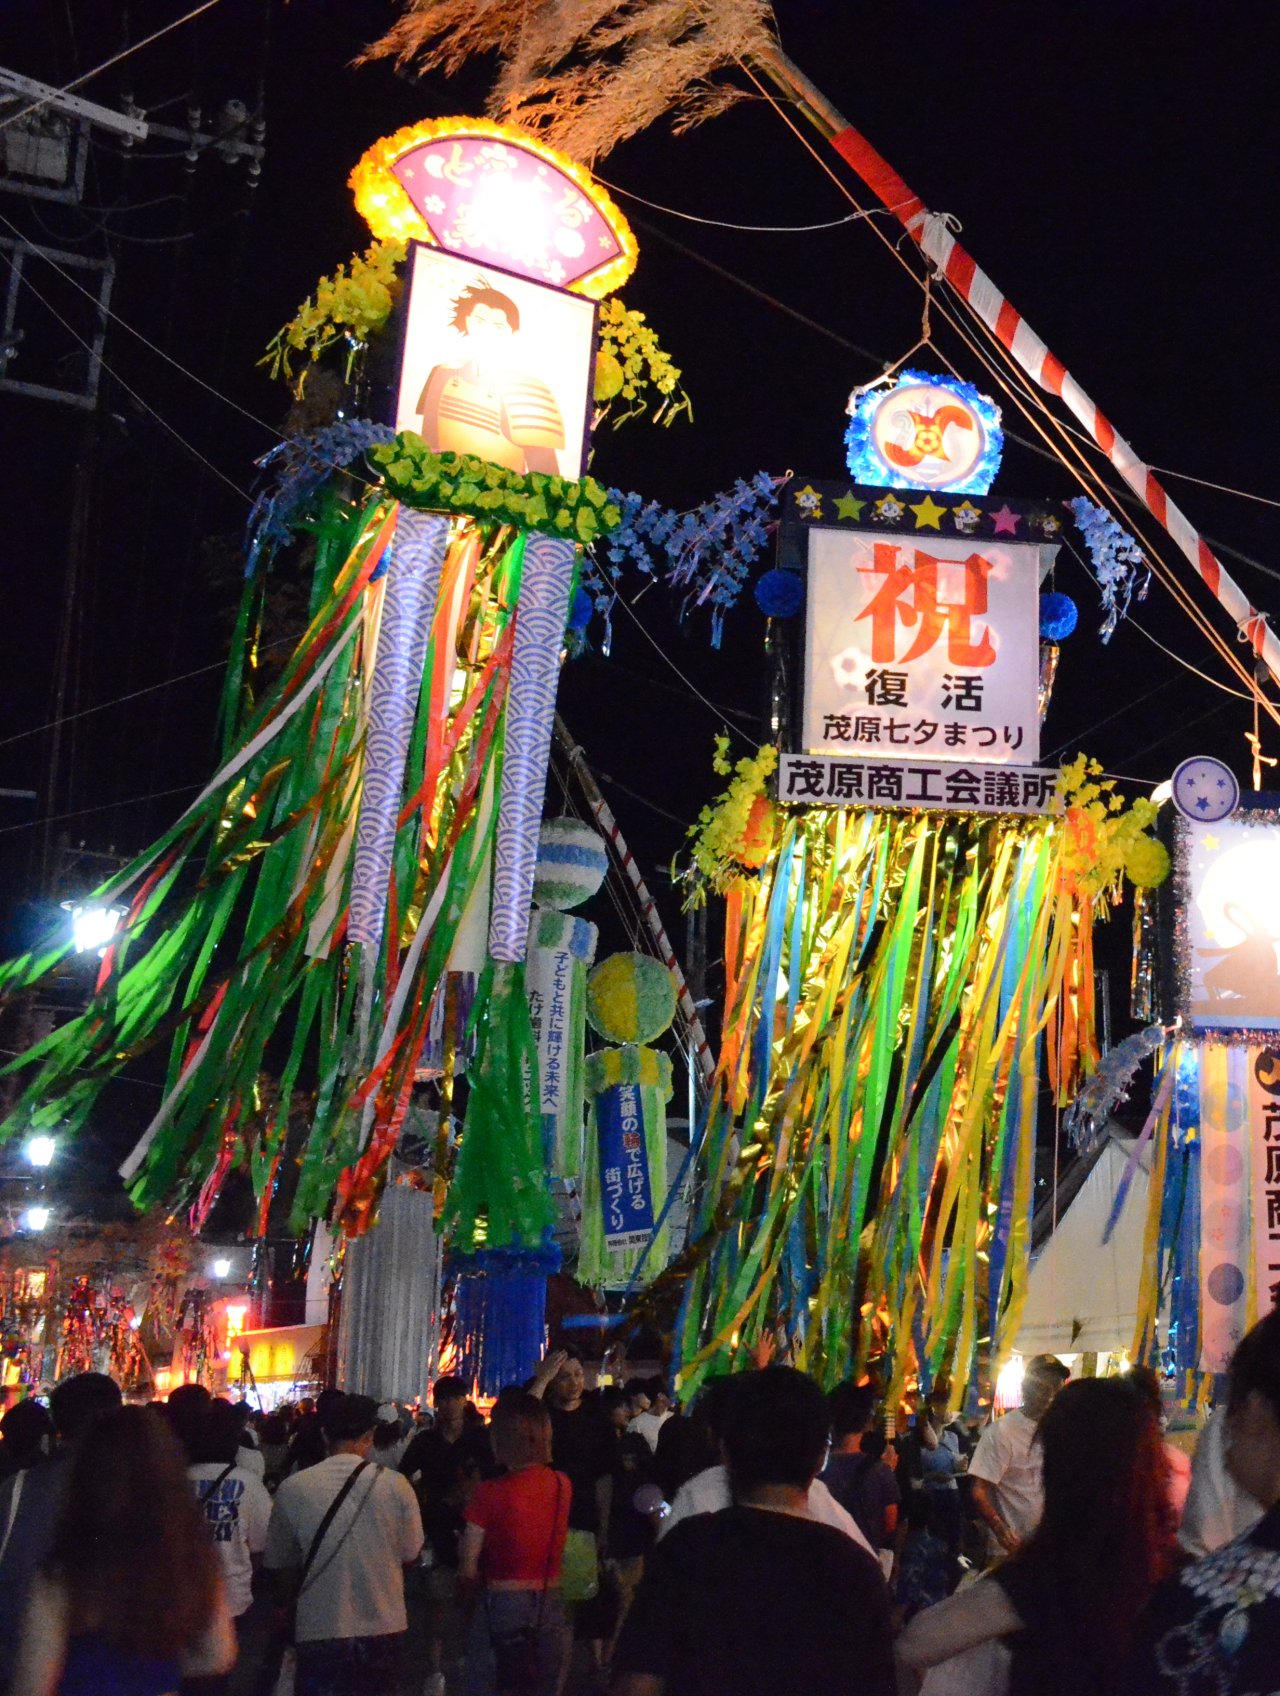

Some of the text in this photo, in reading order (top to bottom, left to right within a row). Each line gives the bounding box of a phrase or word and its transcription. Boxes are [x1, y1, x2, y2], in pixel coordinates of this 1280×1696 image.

[854, 542, 997, 667] 祝
[865, 668, 984, 711] 復活
[823, 713, 1025, 749] 茂原七夕まつり
[786, 759, 1056, 808] 茂原商工会議所
[542, 951, 569, 1108] 子どもと共に輝ける未来へ
[618, 1085, 646, 1210] 笑顔の輪で広げる
[605, 1167, 624, 1230] 街づくり
